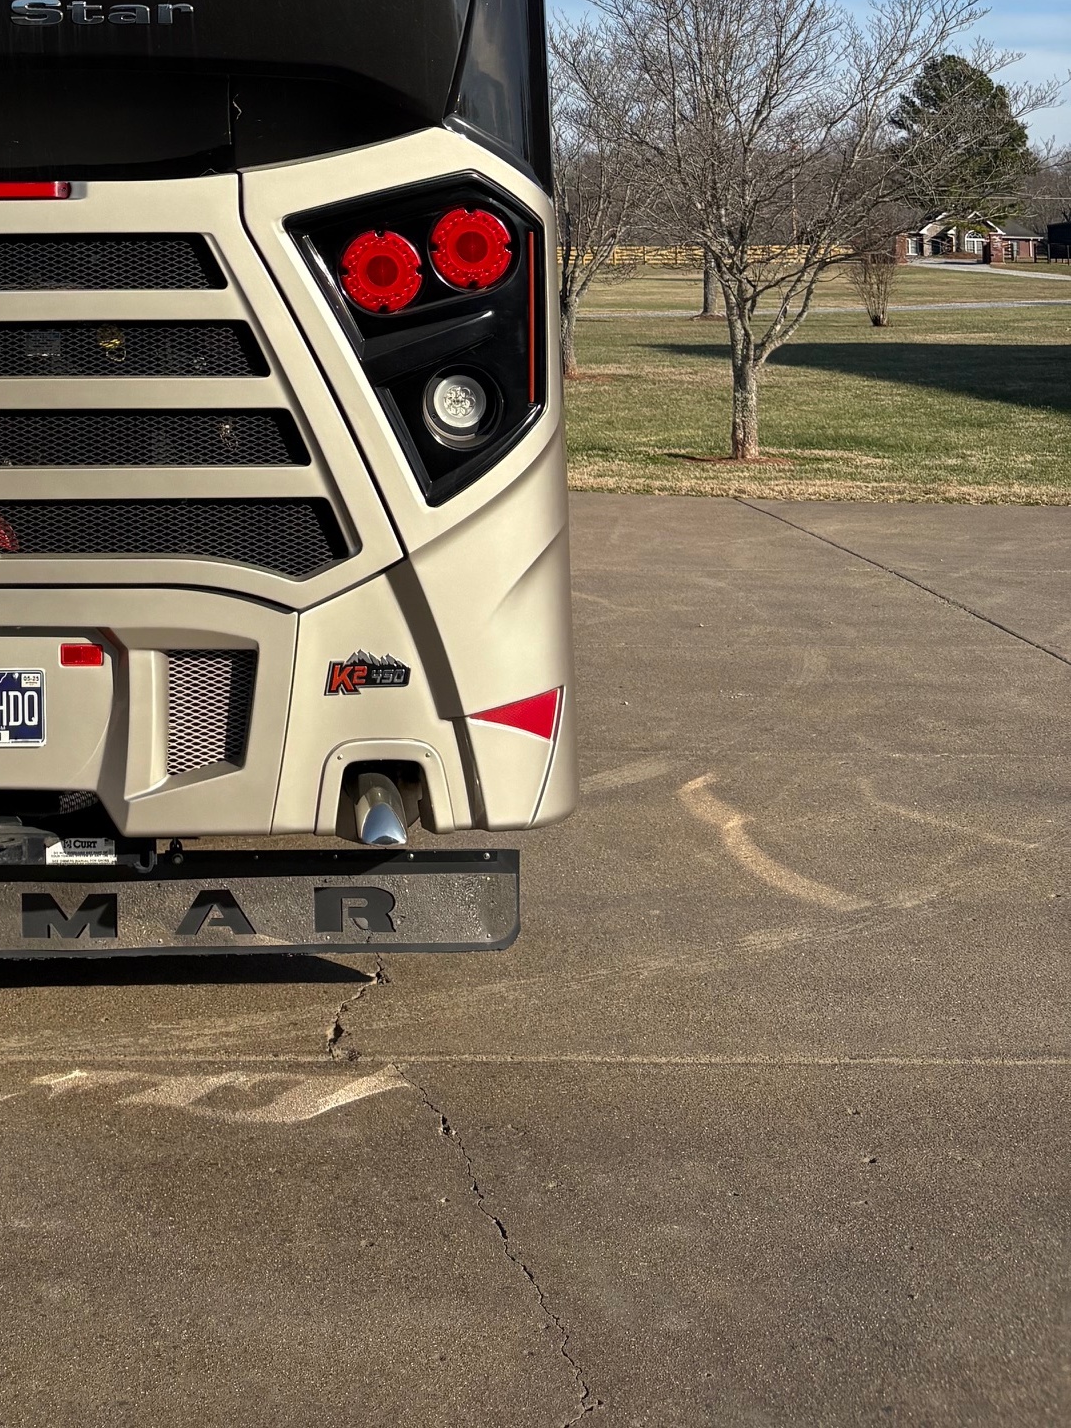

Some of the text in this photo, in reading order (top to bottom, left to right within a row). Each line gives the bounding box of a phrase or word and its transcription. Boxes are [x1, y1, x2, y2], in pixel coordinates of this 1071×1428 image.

[330, 664, 406, 691] K2 450
[73, 839, 98, 849] CURT
